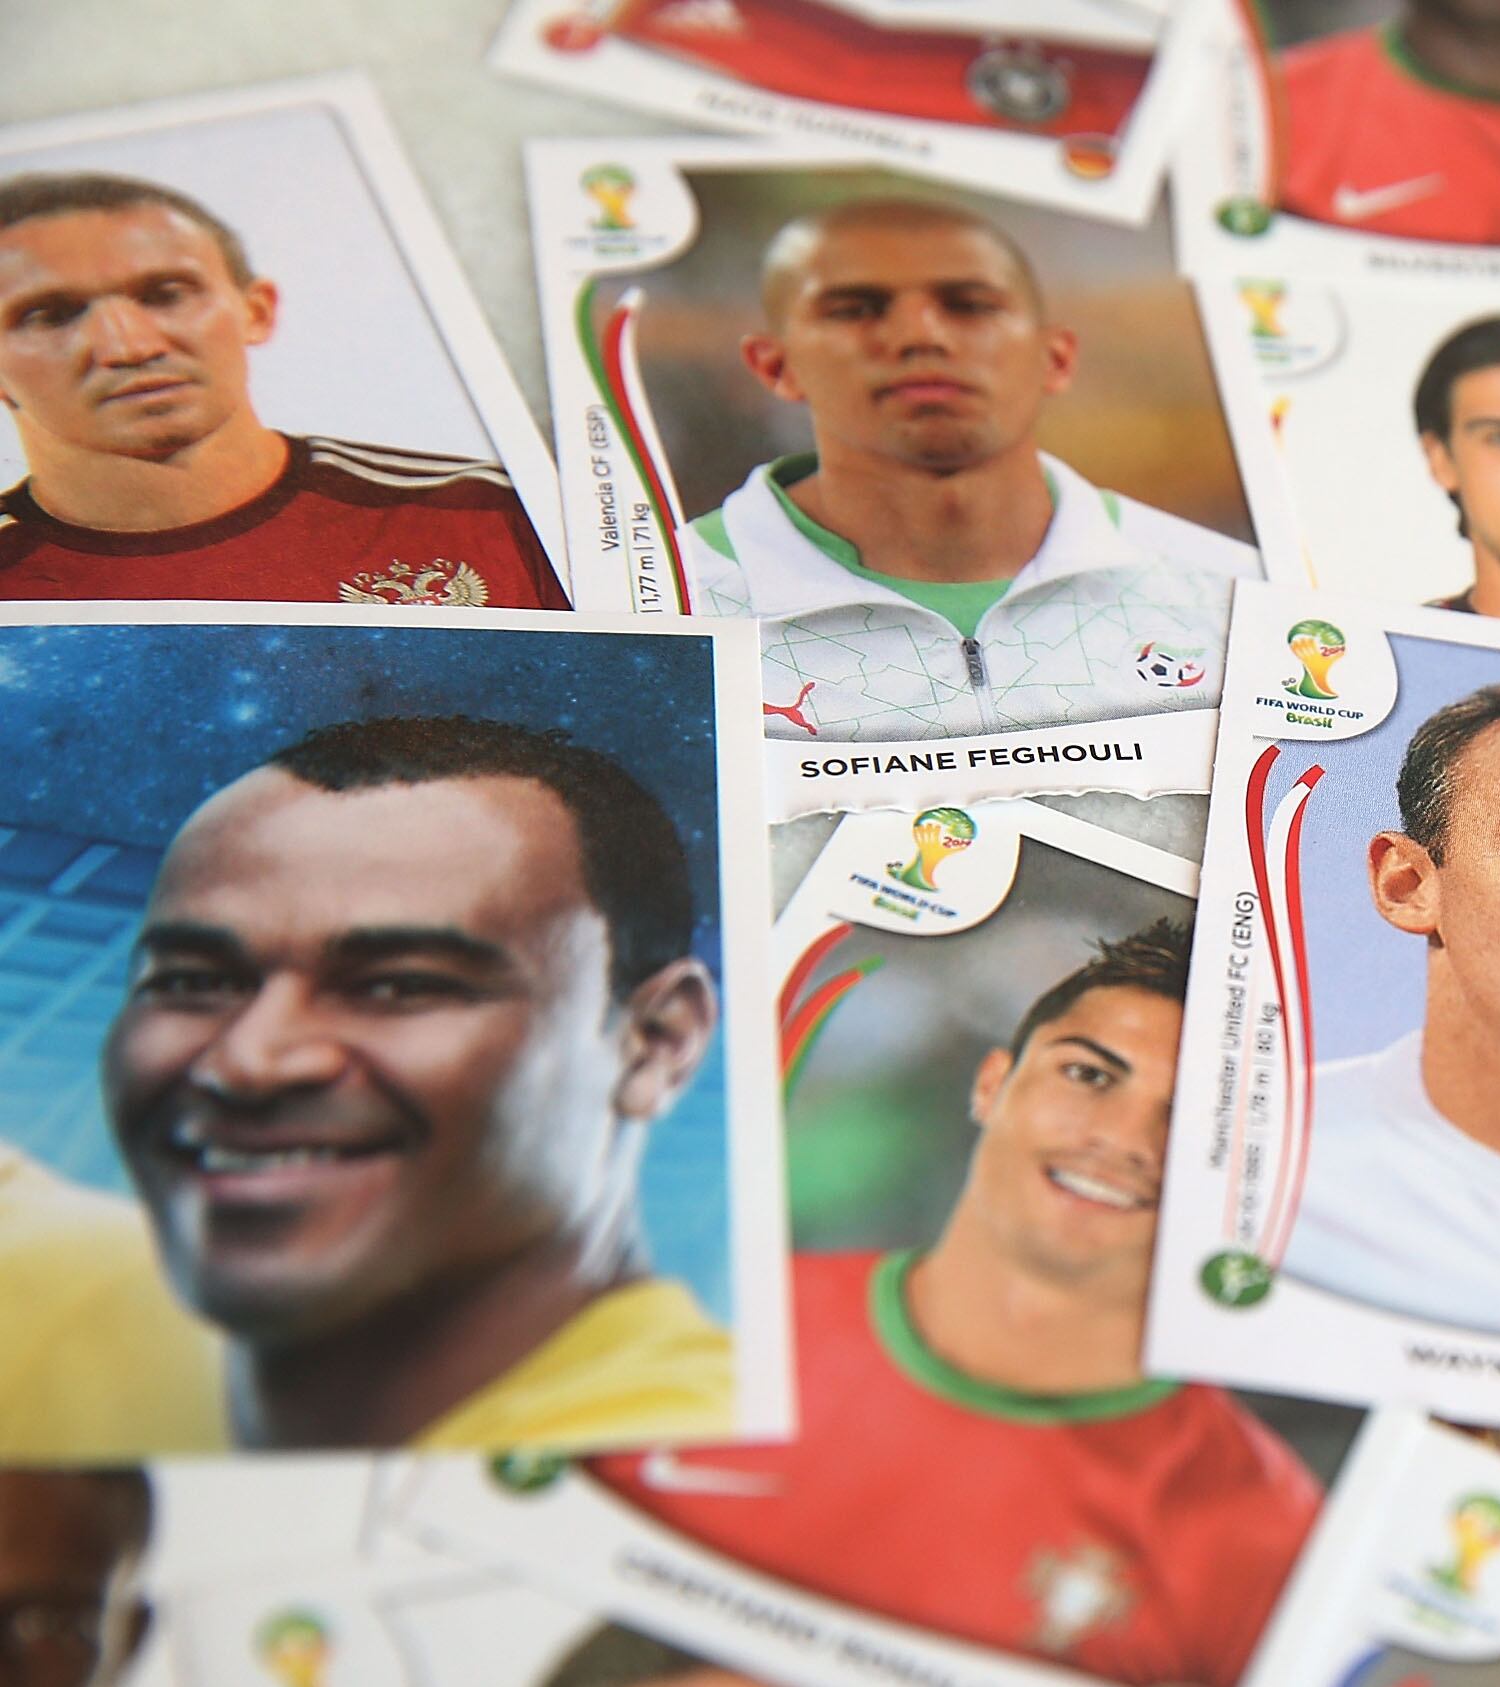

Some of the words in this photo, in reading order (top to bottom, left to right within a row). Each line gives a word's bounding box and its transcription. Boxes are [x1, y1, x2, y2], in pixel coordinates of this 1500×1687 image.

[586, 403, 611, 449] (ESP)
[592, 457, 612, 477] CF
[596, 481, 620, 551] Valencia
[631, 502, 650, 522] kg
[633, 526, 653, 543] 71
[640, 555, 654, 570] m
[638, 575, 663, 608] 1,77
[1255, 697, 1284, 709] FIFA
[1286, 701, 1336, 716] WORLD
[1338, 709, 1364, 720] CUP
[1286, 713, 1333, 728] Brasil
[800, 750, 957, 778] SOFIANE
[967, 743, 1143, 768] FEGHOULI
[1232, 891, 1259, 949] (ENG)
[1227, 954, 1249, 981] FC
